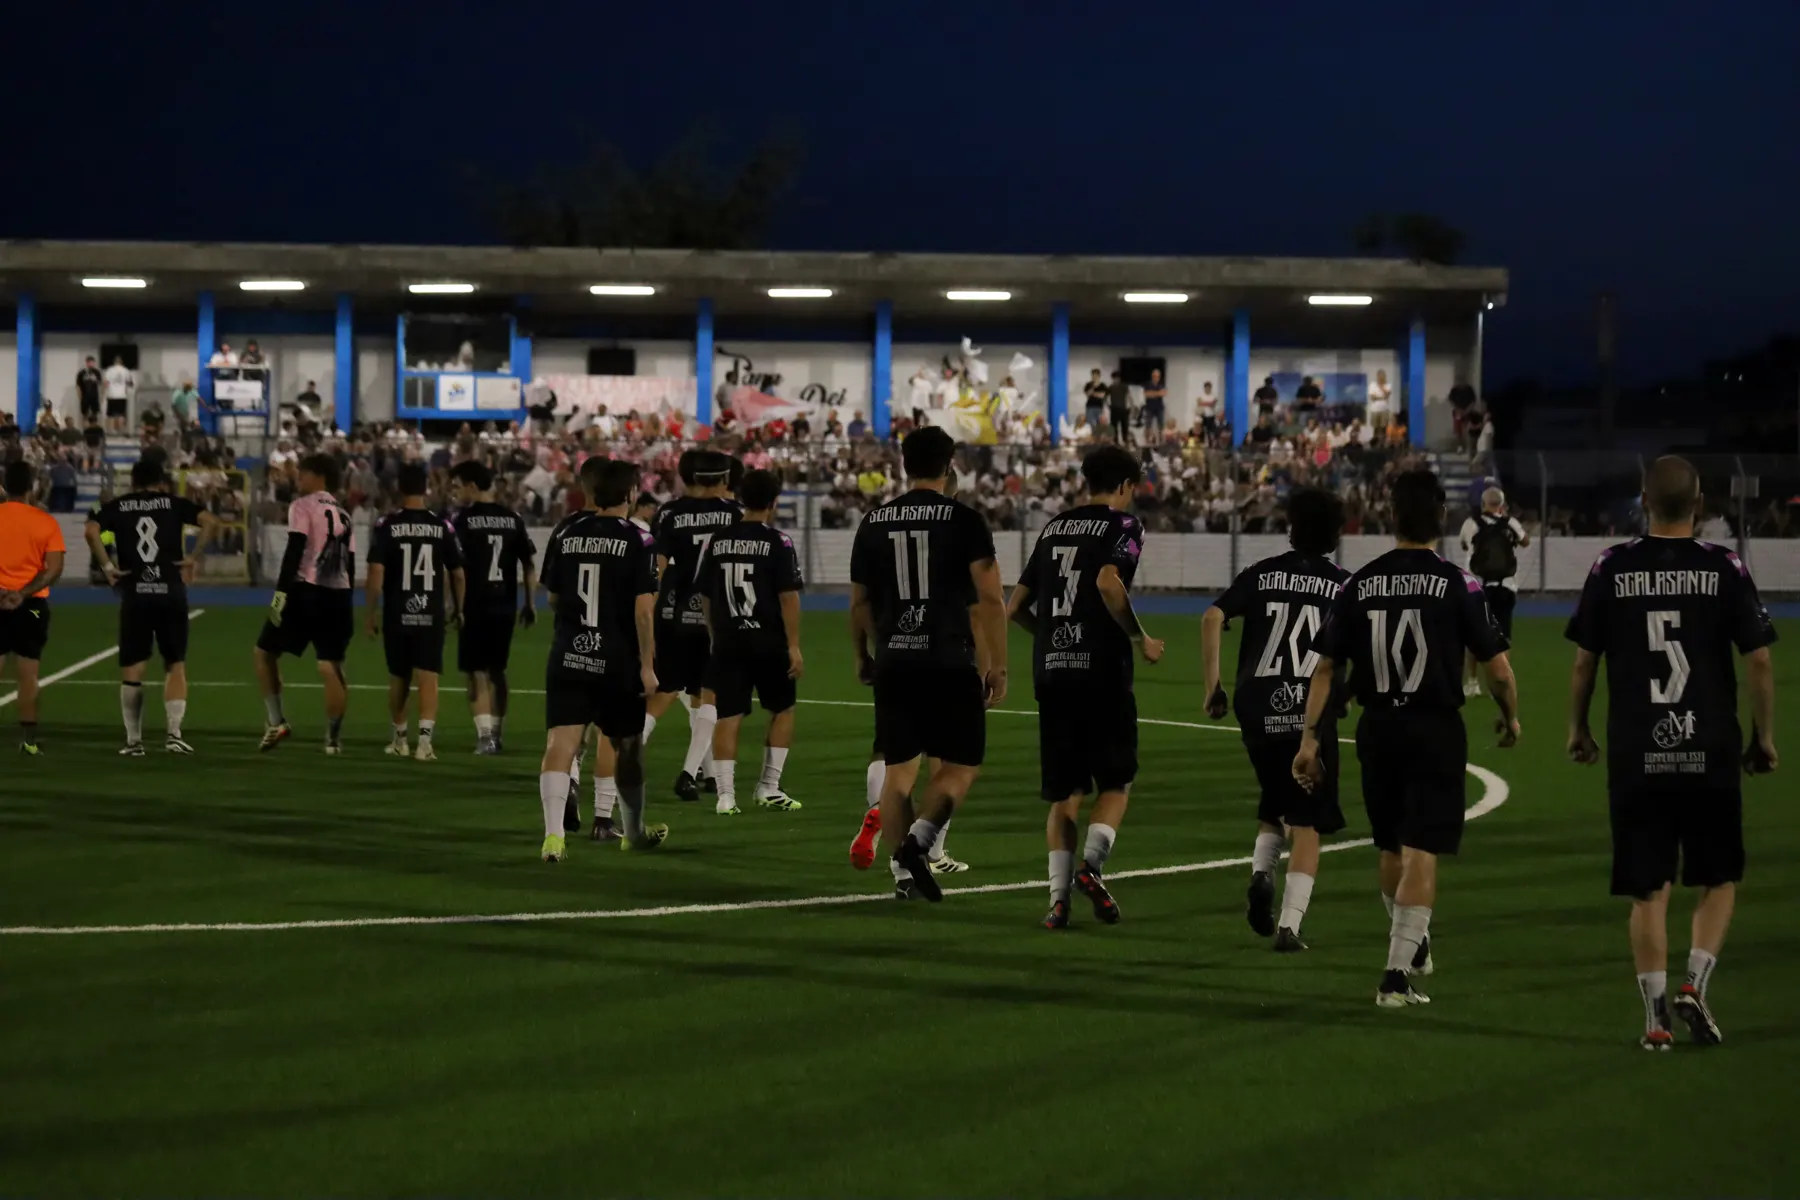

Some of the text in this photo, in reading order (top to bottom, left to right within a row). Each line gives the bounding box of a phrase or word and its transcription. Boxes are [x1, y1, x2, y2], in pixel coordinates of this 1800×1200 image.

[674, 511, 732, 529] SCALASANTA
[869, 505, 954, 523] SCALASANTA
[135, 516, 159, 562] 8
[488, 534, 504, 581] 2
[561, 536, 628, 557] SCALASANTA
[692, 532, 715, 584] 7
[712, 539, 771, 556] SCALASANTA
[400, 543, 436, 591] 14
[888, 530, 930, 600] 11
[1052, 546, 1081, 617] 3
[1358, 574, 1448, 601] SCALASANTA
[1614, 570, 1719, 598] SCALASANTA
[577, 563, 600, 627] 9
[720, 562, 757, 617] 15
[1254, 602, 1322, 677] 20
[1367, 608, 1428, 693] 10
[1647, 610, 1691, 703] 5
